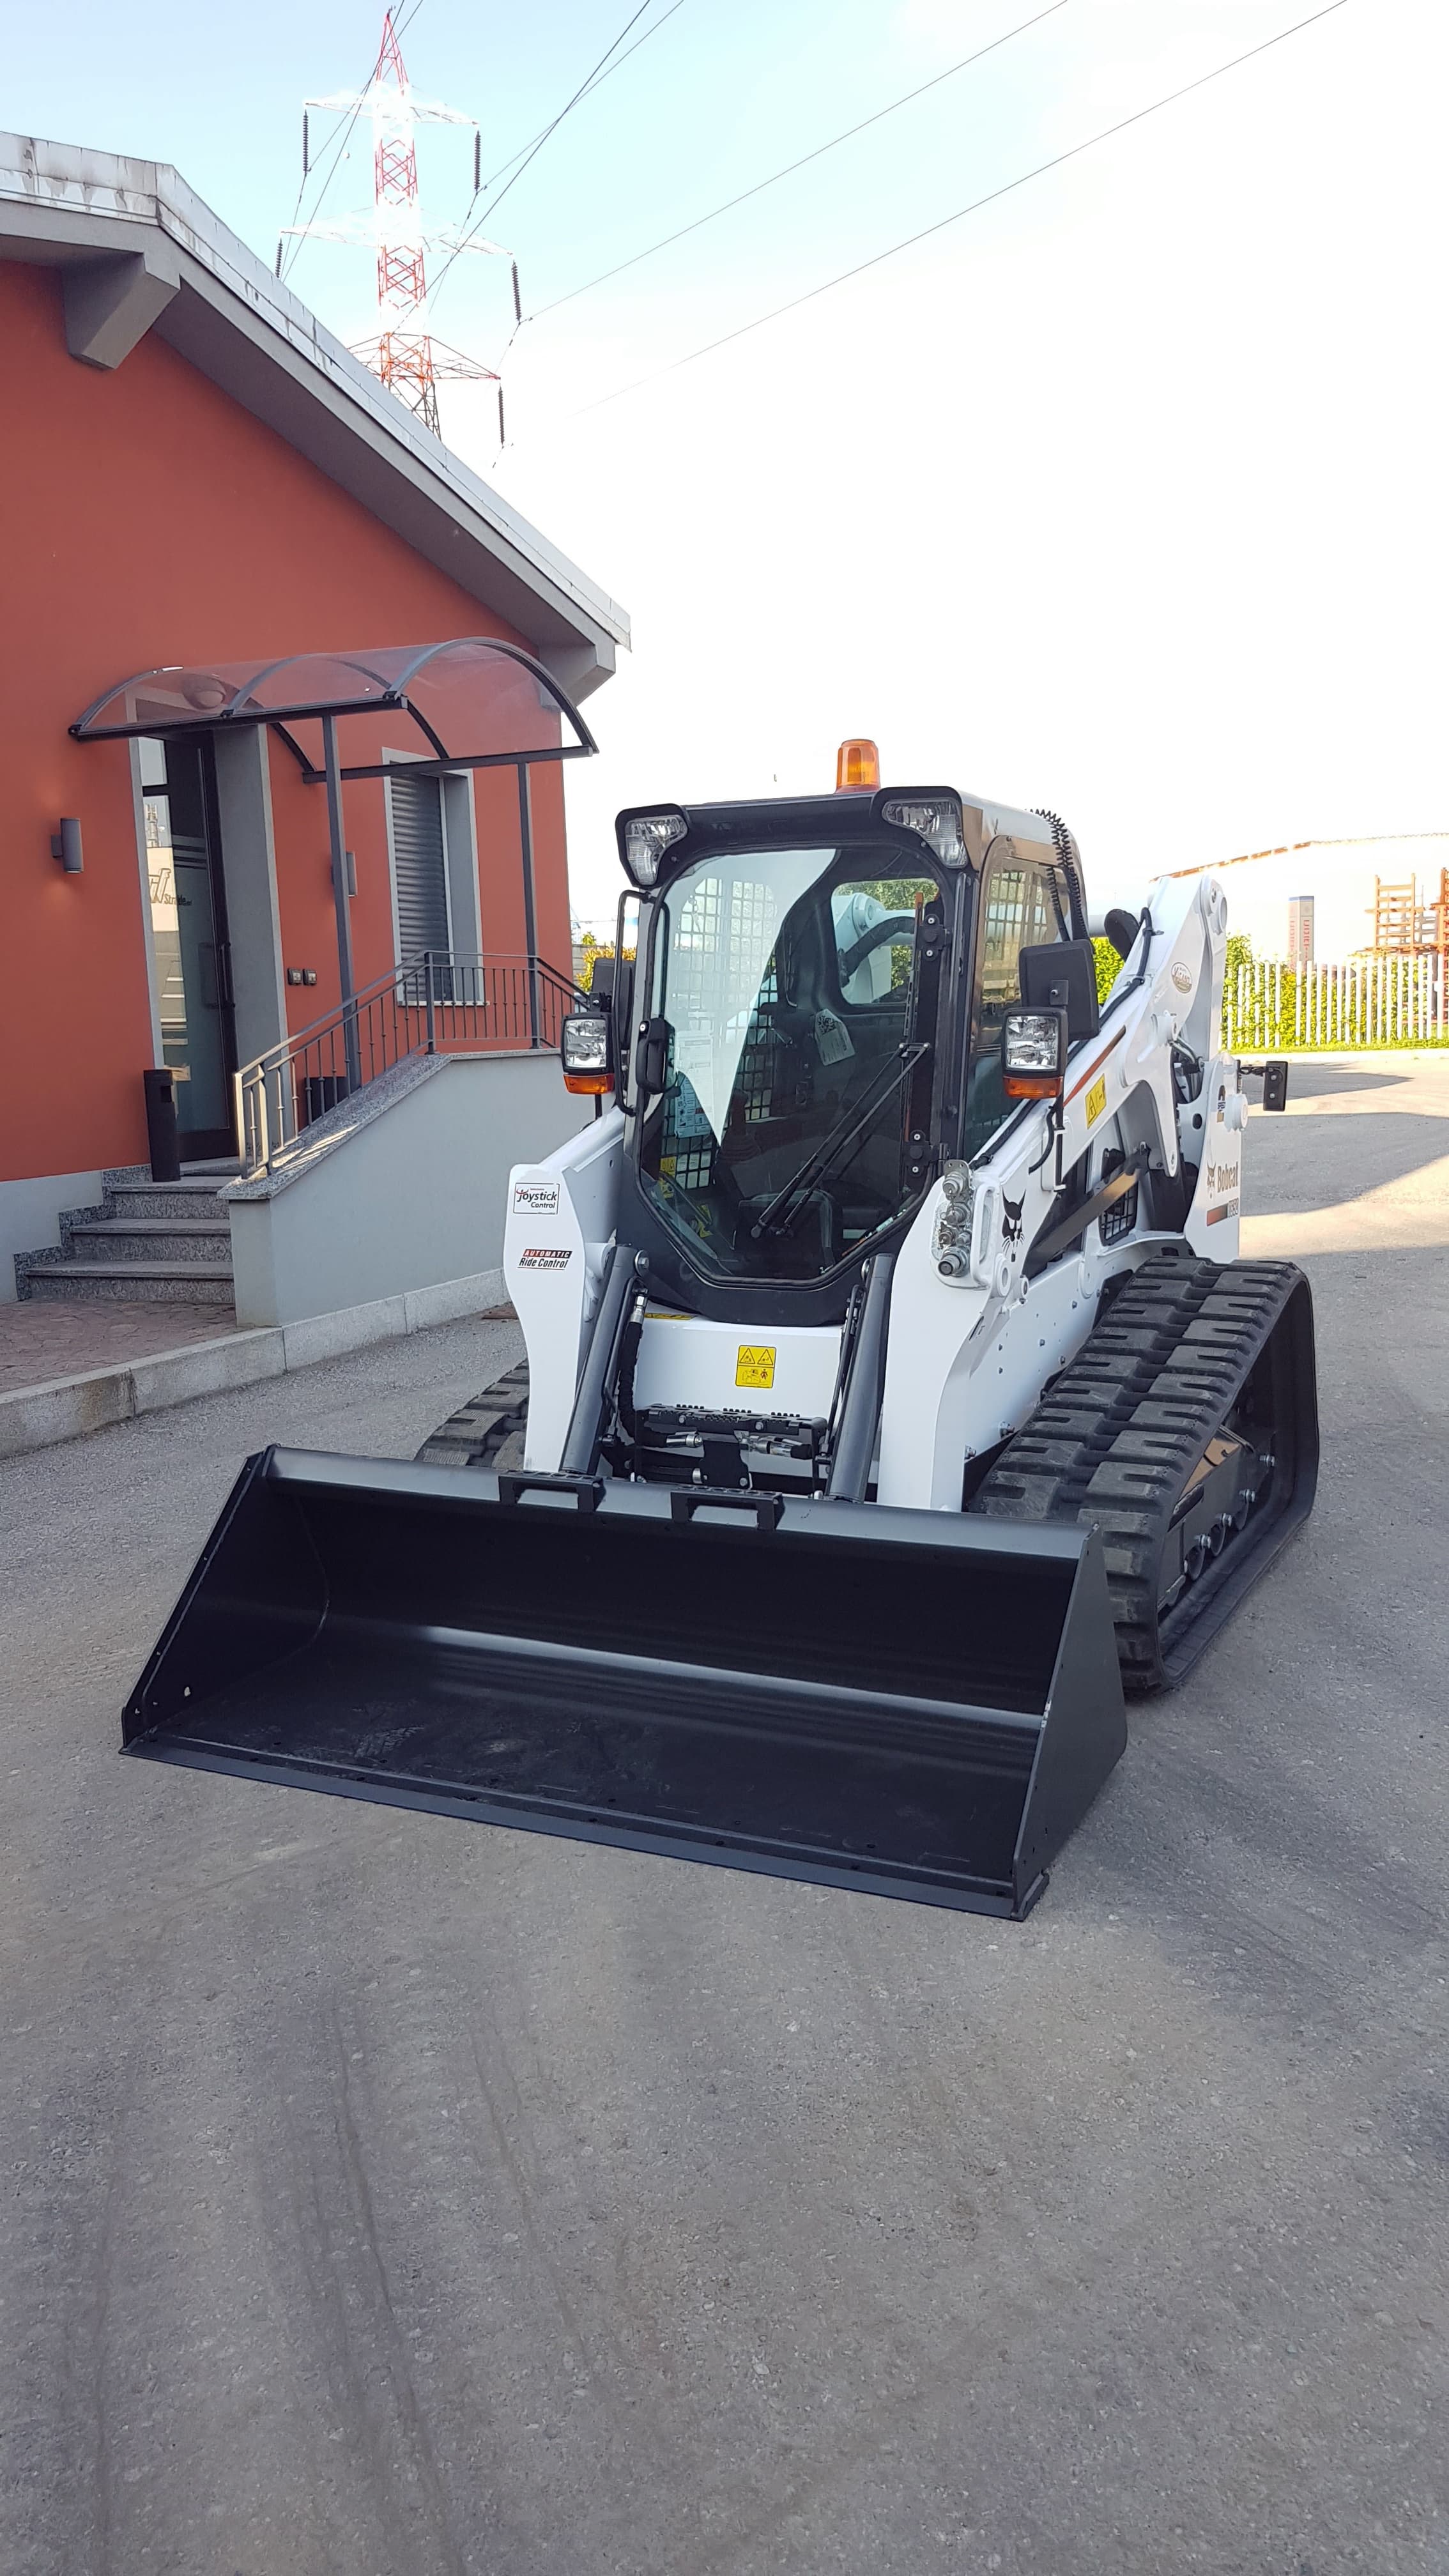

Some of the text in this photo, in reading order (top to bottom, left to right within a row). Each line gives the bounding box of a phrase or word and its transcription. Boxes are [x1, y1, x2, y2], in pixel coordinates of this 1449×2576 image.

[1217, 1161, 1238, 1193] Bobcat
[524, 1250, 571, 1258] AUTOMATIC
[519, 1257, 569, 1268] Ride Control
